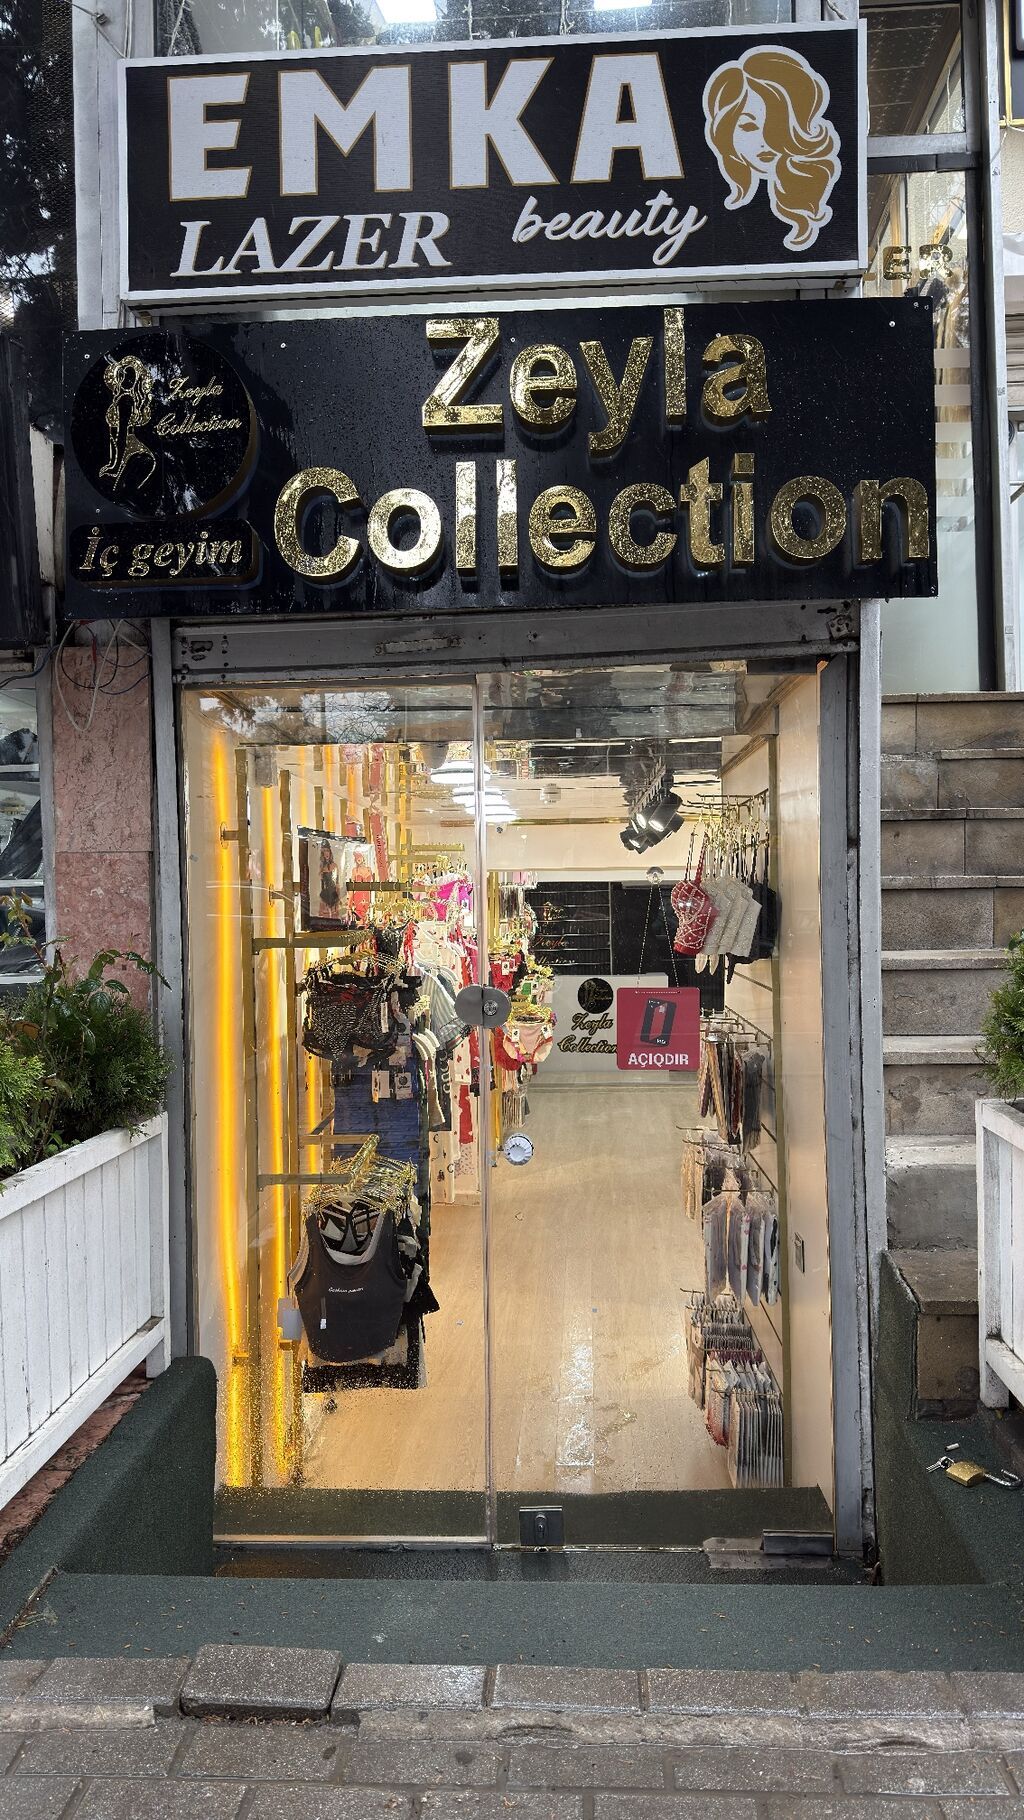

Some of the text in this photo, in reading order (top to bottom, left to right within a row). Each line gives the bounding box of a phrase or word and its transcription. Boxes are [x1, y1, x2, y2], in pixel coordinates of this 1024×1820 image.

[167, 52, 685, 202] EMKA
[169, 211, 453, 277] LAZER
[511, 190, 709, 266] beauty
[864, 243, 954, 281] ER
[167, 375, 224, 406] Zeyla
[422, 307, 773, 456] Zeyla
[154, 412, 243, 436] Collection
[273, 452, 931, 581] Collection
[79, 526, 244, 577] İç geyim
[627, 1053, 690, 1068] AÇIQDIR
